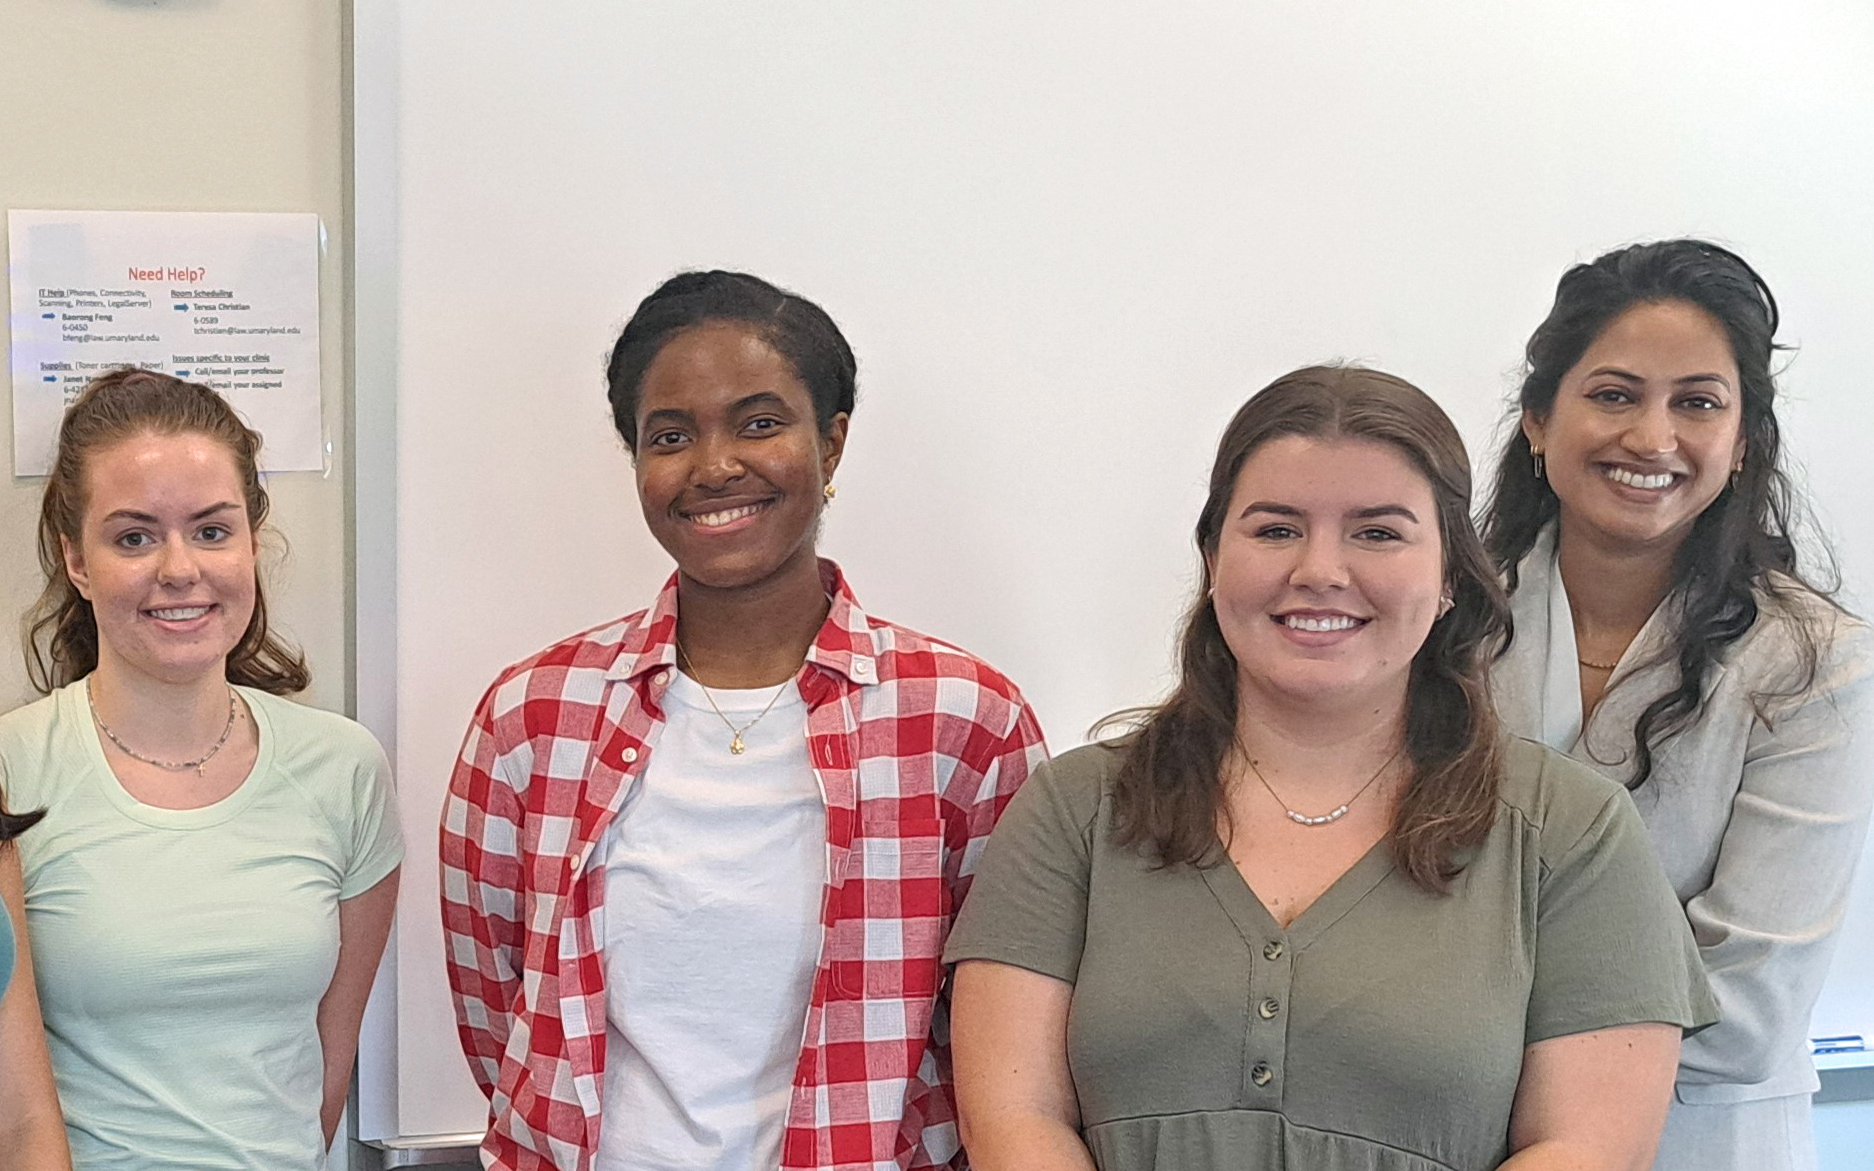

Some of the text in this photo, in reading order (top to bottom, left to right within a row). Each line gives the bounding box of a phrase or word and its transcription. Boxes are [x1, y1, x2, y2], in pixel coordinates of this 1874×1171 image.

[128, 267, 206, 284] Need Help?
[170, 290, 233, 298] Room Scheduling
[76, 300, 106, 308] Printers,
[95, 314, 113, 322] Feng
[172, 354, 270, 363] Issues specific to your clinic
[76, 362, 98, 370] (Toner
[195, 368, 232, 376] Call/email
[251, 367, 285, 375] professor
[233, 382, 250, 390] your
[252, 381, 282, 389] assigned
